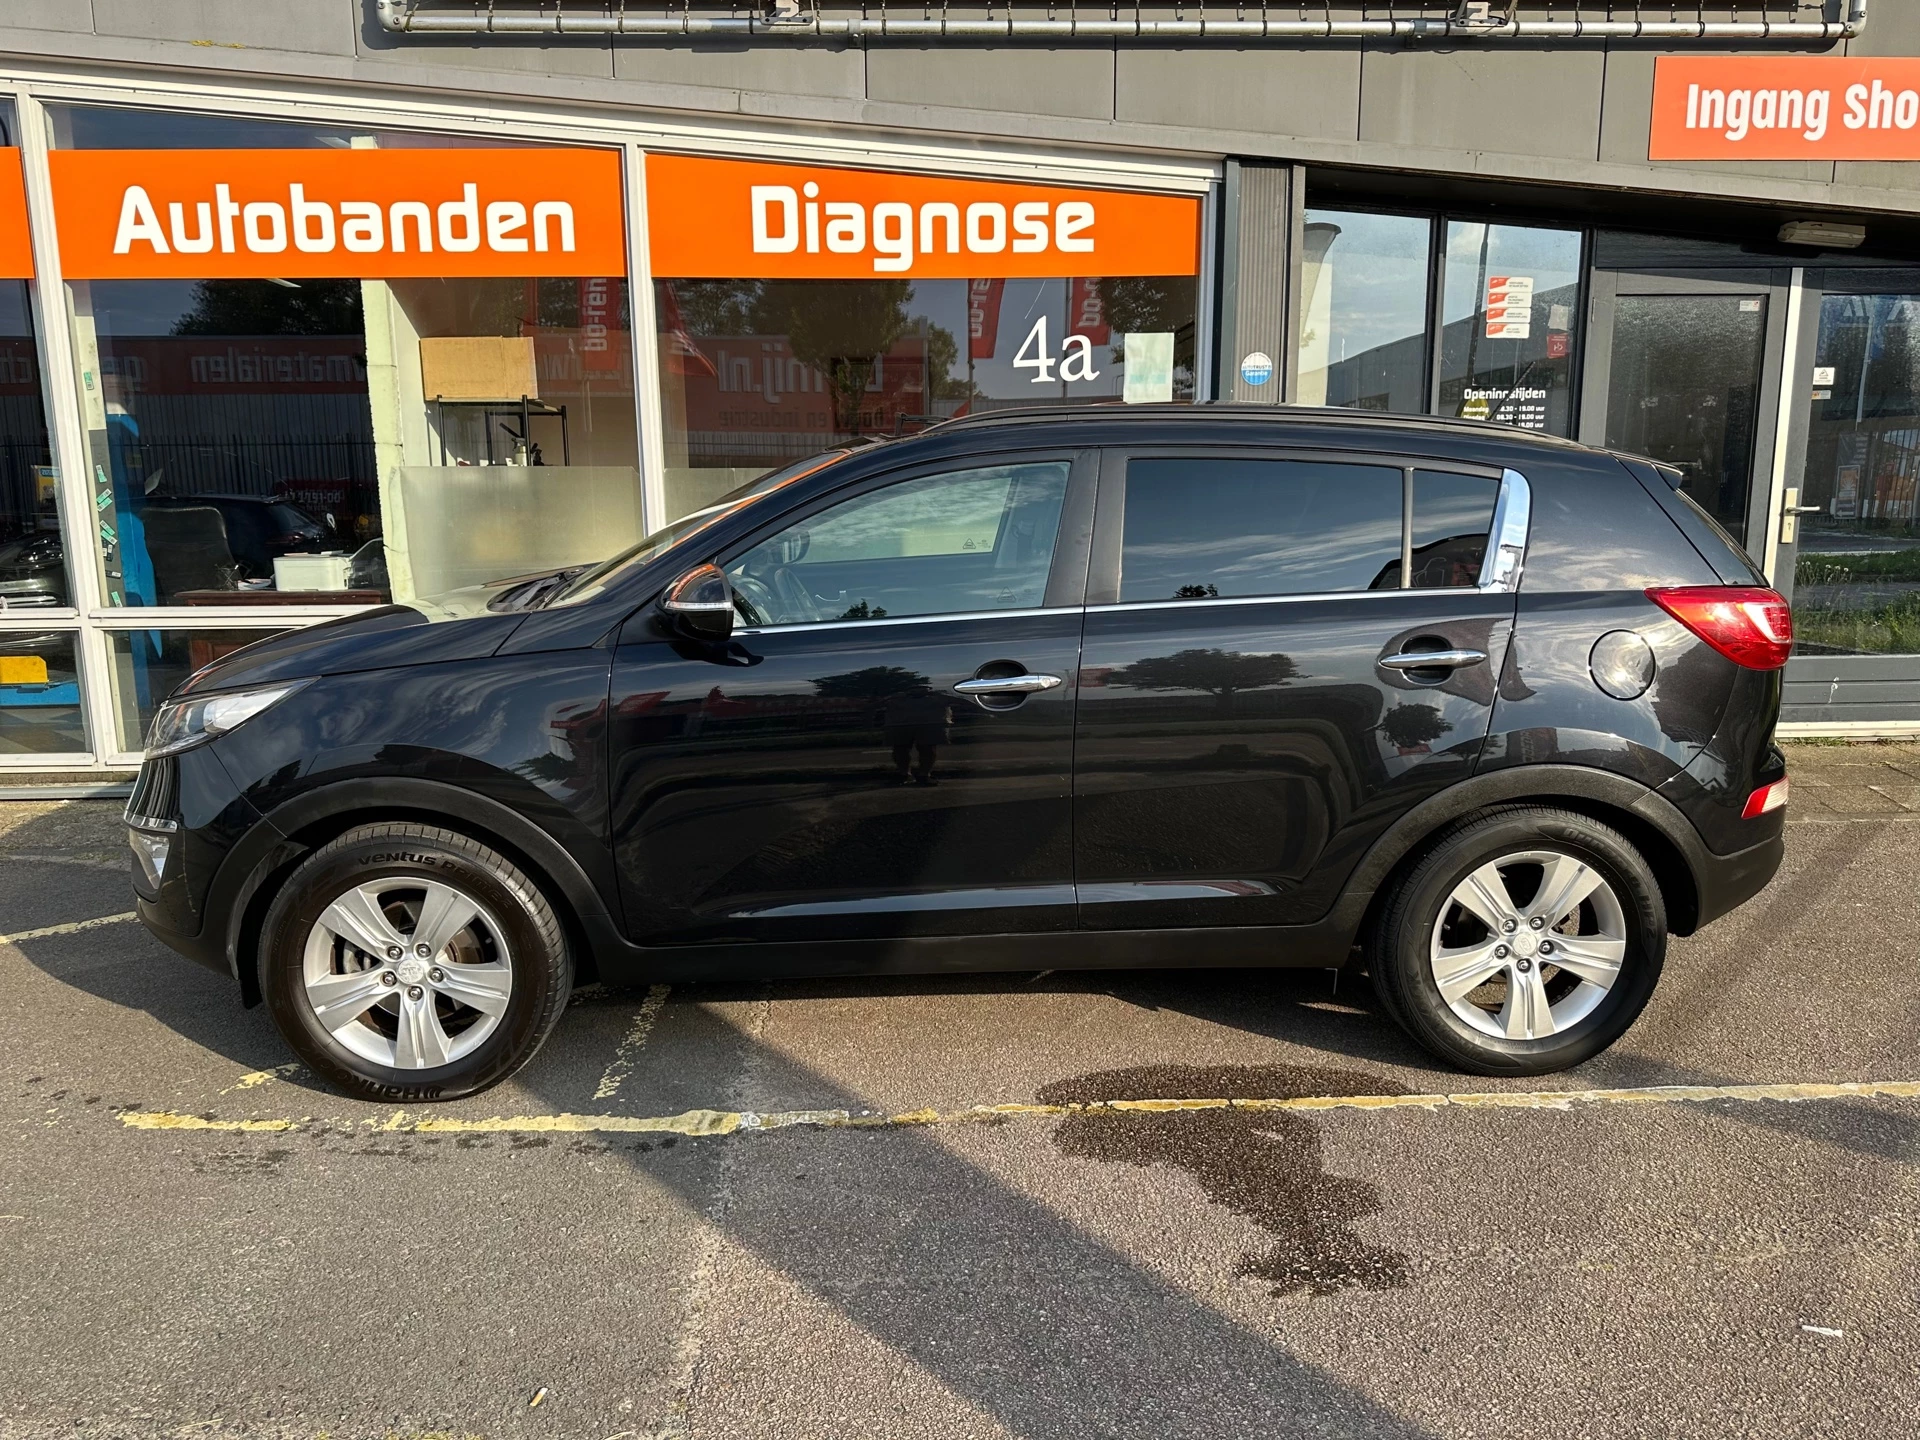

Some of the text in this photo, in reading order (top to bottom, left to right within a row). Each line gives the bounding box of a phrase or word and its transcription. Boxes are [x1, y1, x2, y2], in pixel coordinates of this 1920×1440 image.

[1686, 83, 1830, 141] Ingang
[113, 182, 576, 255] Autobanden
[750, 181, 1096, 272] Diagnose
[1012, 315, 1100, 383] 4a
